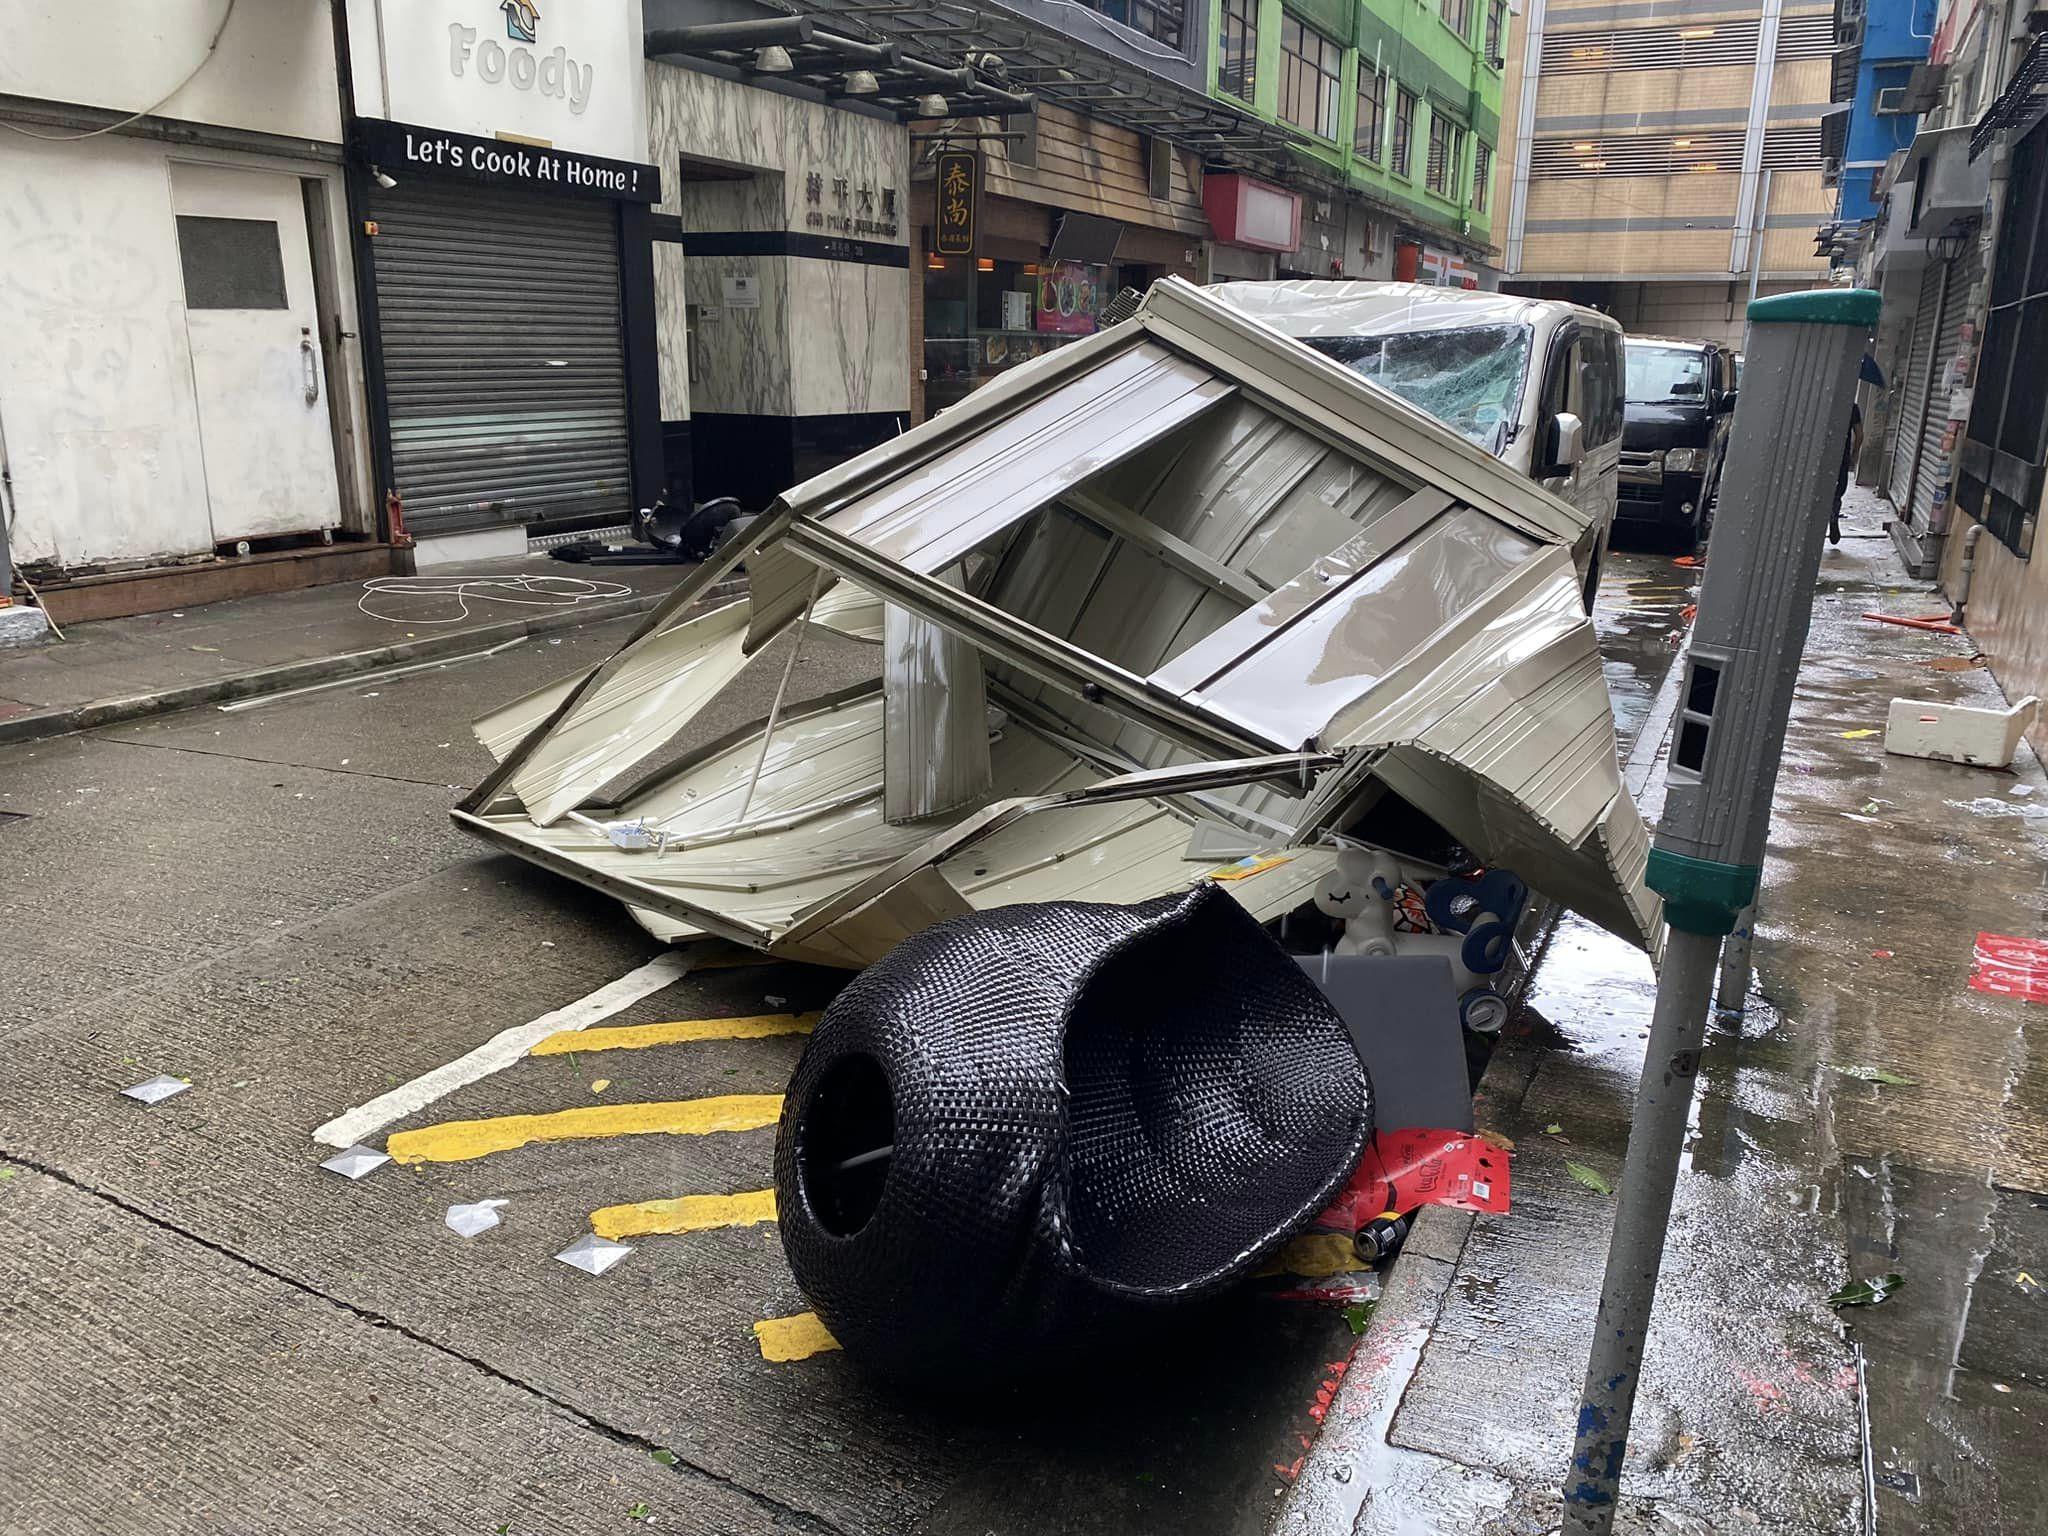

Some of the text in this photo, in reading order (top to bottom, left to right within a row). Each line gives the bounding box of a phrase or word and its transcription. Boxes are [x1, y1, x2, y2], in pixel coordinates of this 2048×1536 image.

[449, 22, 593, 115] Foody
[406, 134, 639, 192] Let's Cook At Home !
